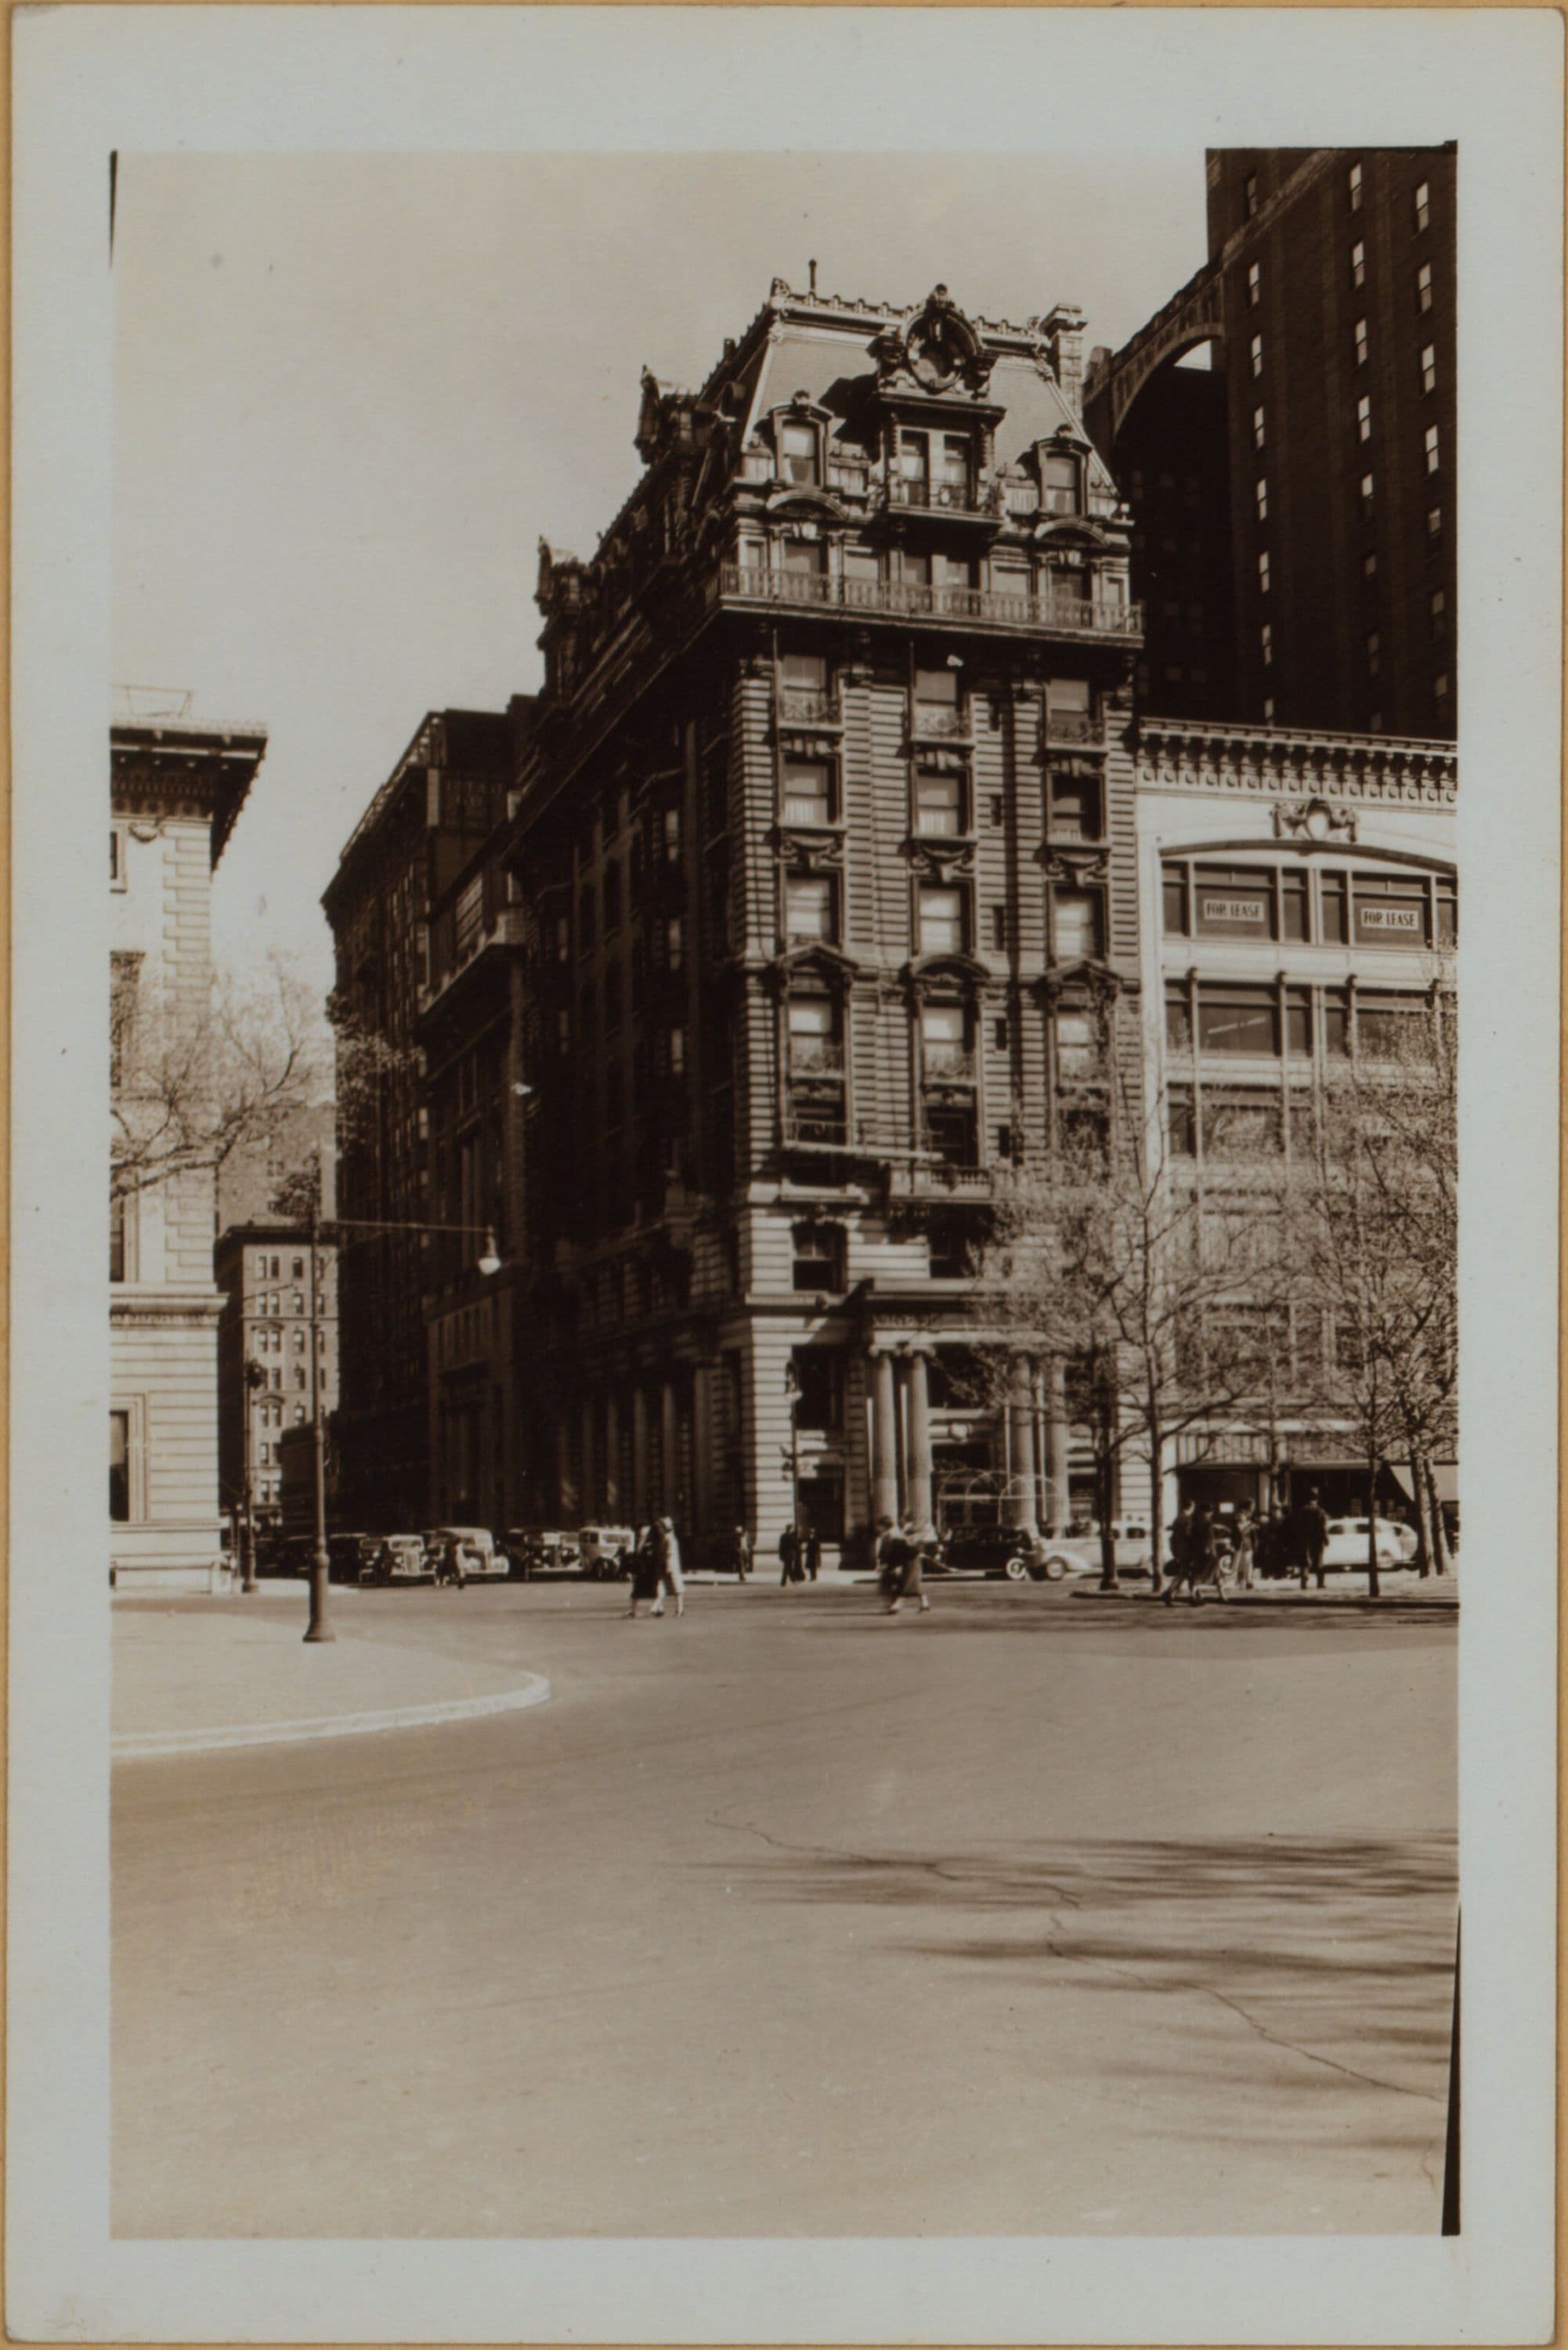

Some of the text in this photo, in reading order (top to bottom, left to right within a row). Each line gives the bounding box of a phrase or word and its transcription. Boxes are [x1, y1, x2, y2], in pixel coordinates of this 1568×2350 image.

[1207, 902, 1259, 917] FOR LEASE
[1364, 910, 1414, 927] FOR LEASE
